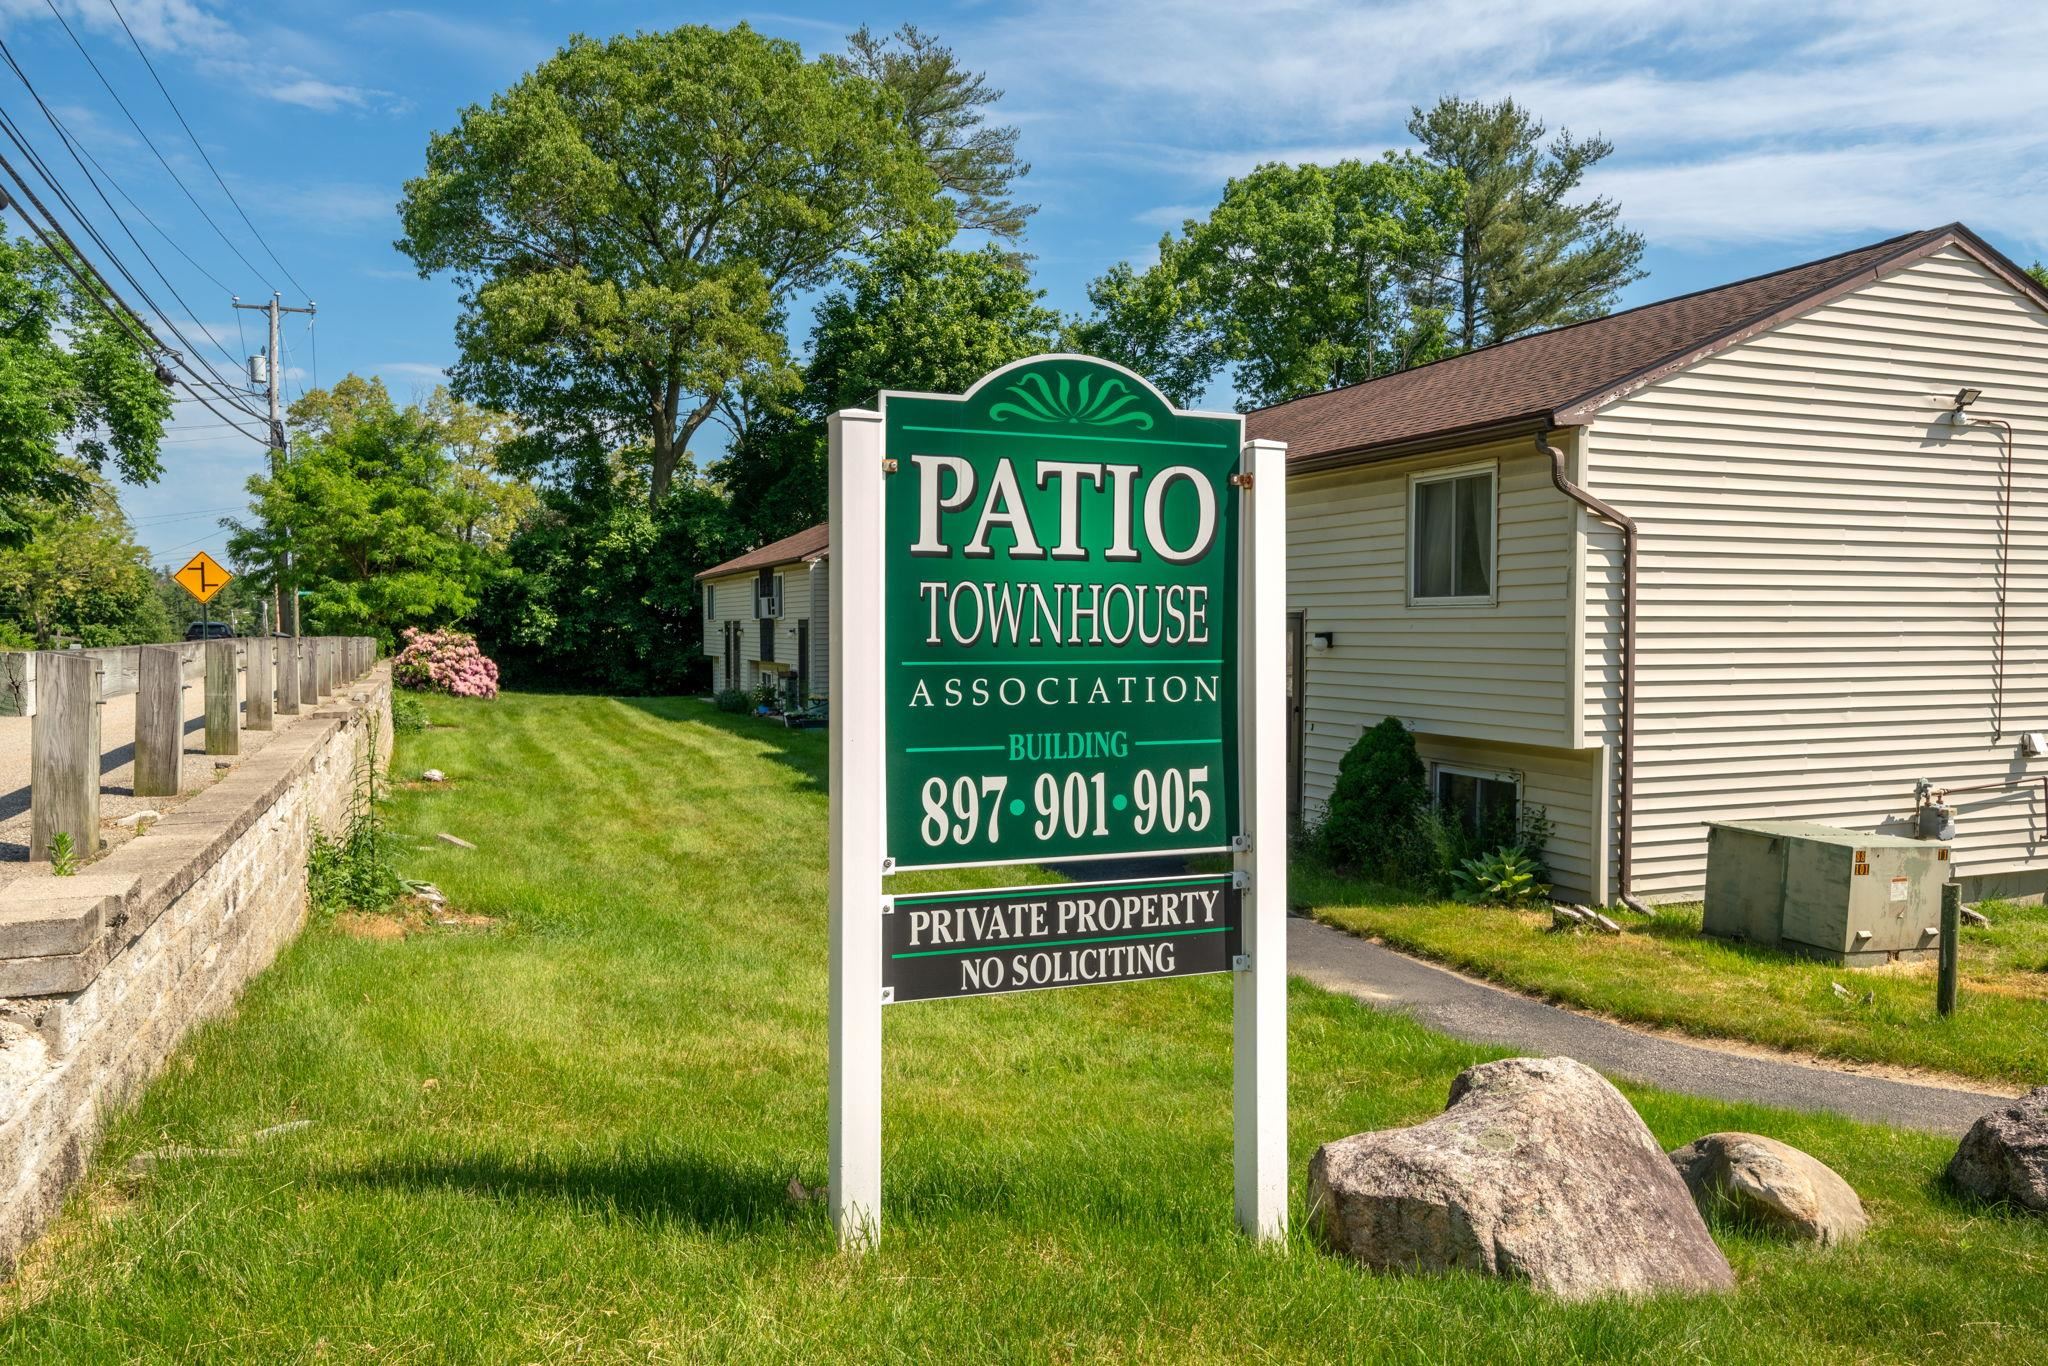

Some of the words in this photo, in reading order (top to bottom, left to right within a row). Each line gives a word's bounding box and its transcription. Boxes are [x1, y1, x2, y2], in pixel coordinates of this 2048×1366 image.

[911, 454, 1217, 565] PATIO
[920, 581, 1209, 645] TOWNHOUSE
[909, 675, 1219, 707] ASSOCIATION
[1008, 731, 1128, 761] BUILDING
[921, 776, 1007, 846] 897
[1034, 772, 1109, 840] 901
[1133, 765, 1211, 834] 905
[1855, 864, 1869, 875] 101
[909, 901, 1048, 946] PRIVATE
[1056, 890, 1220, 935] PROPERTY
[960, 957, 1005, 991] NO
[1012, 943, 1175, 986] SOLICITING
